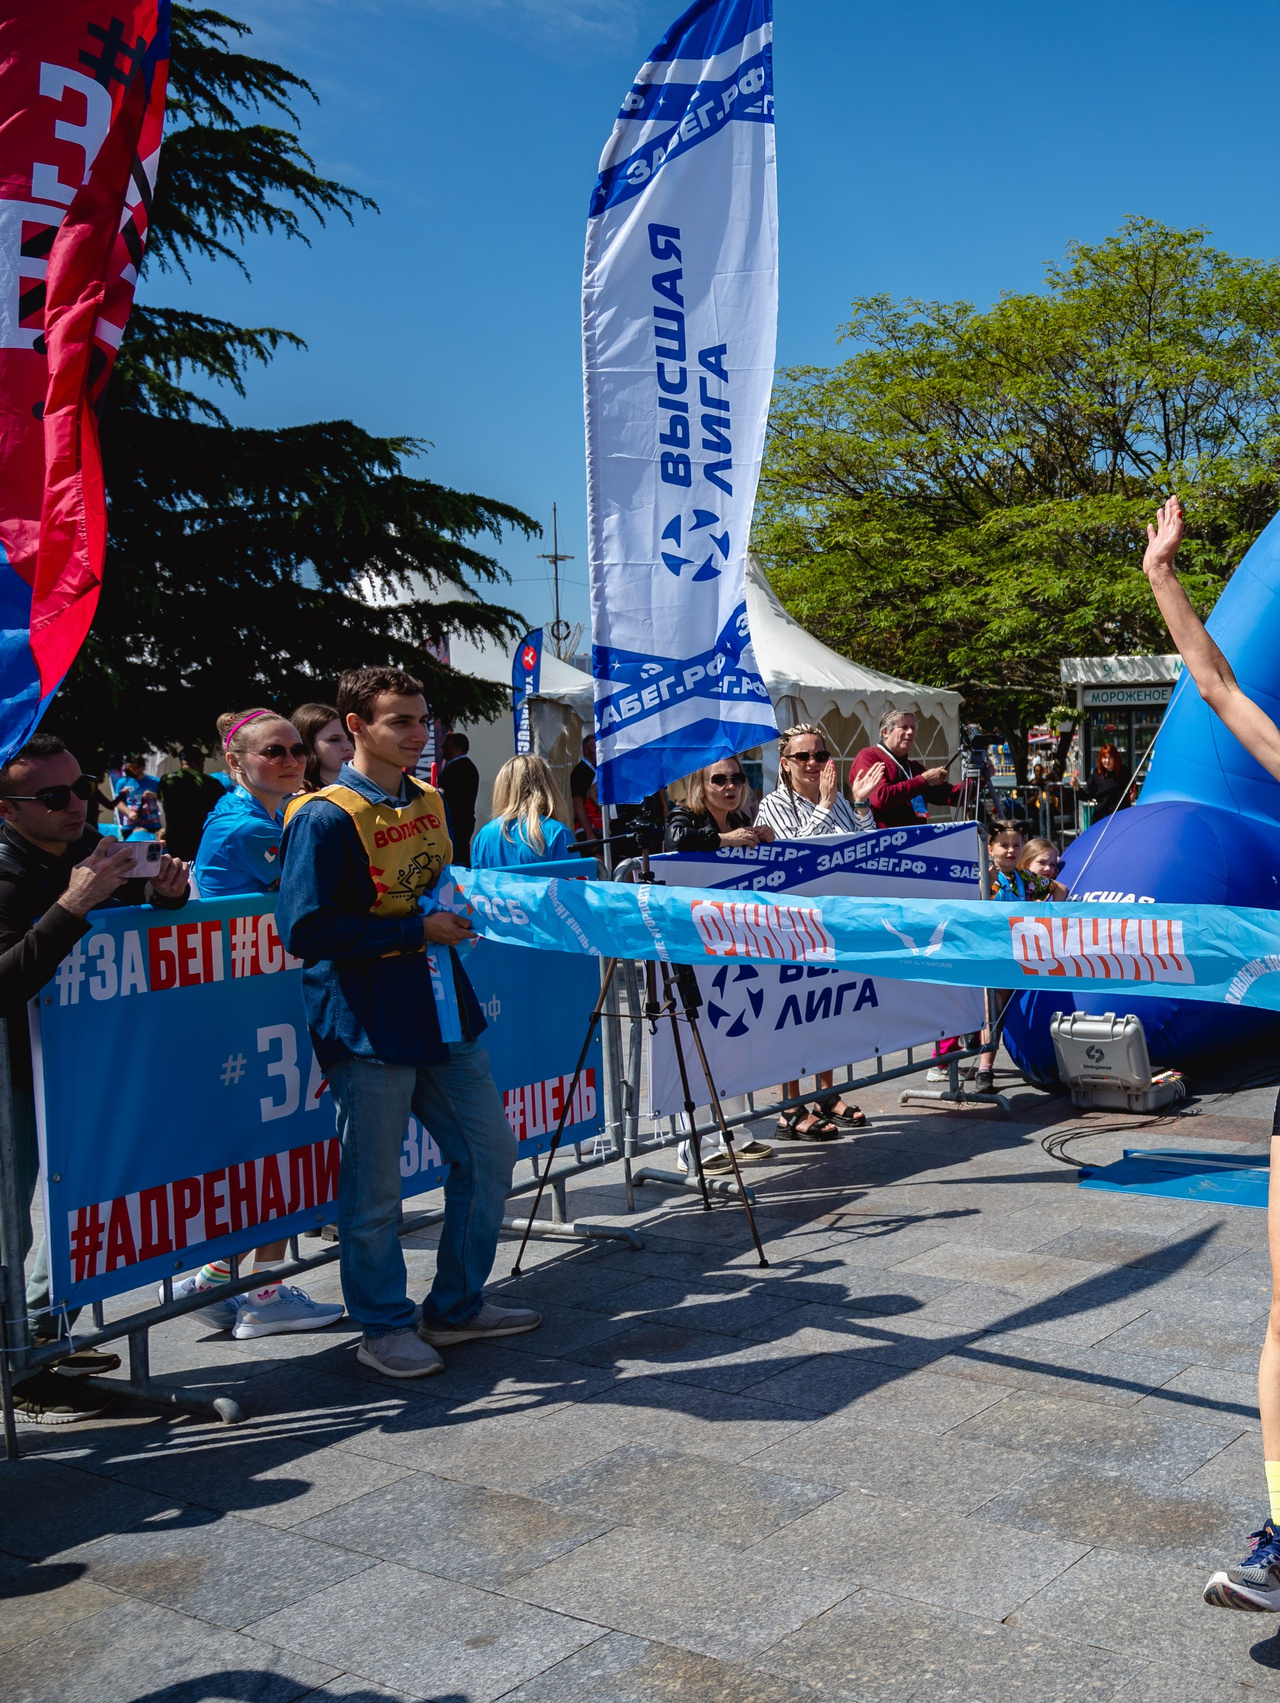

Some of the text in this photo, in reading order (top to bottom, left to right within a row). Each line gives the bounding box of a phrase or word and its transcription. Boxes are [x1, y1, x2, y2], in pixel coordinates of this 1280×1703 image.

[648, 222, 692, 489] ВЫСШАЯ
[697, 343, 734, 498] ЛИГА
[1091, 689, 1168, 703] МОРОЖЕНОЕ
[816, 831, 908, 872] ЗАБЕГ.РФ
[470, 894, 530, 925] ПСБ
[691, 900, 836, 963] ФИНИШ
[1009, 916, 1195, 984] ФИНИШ
[774, 977, 880, 1031] ЛИГА
